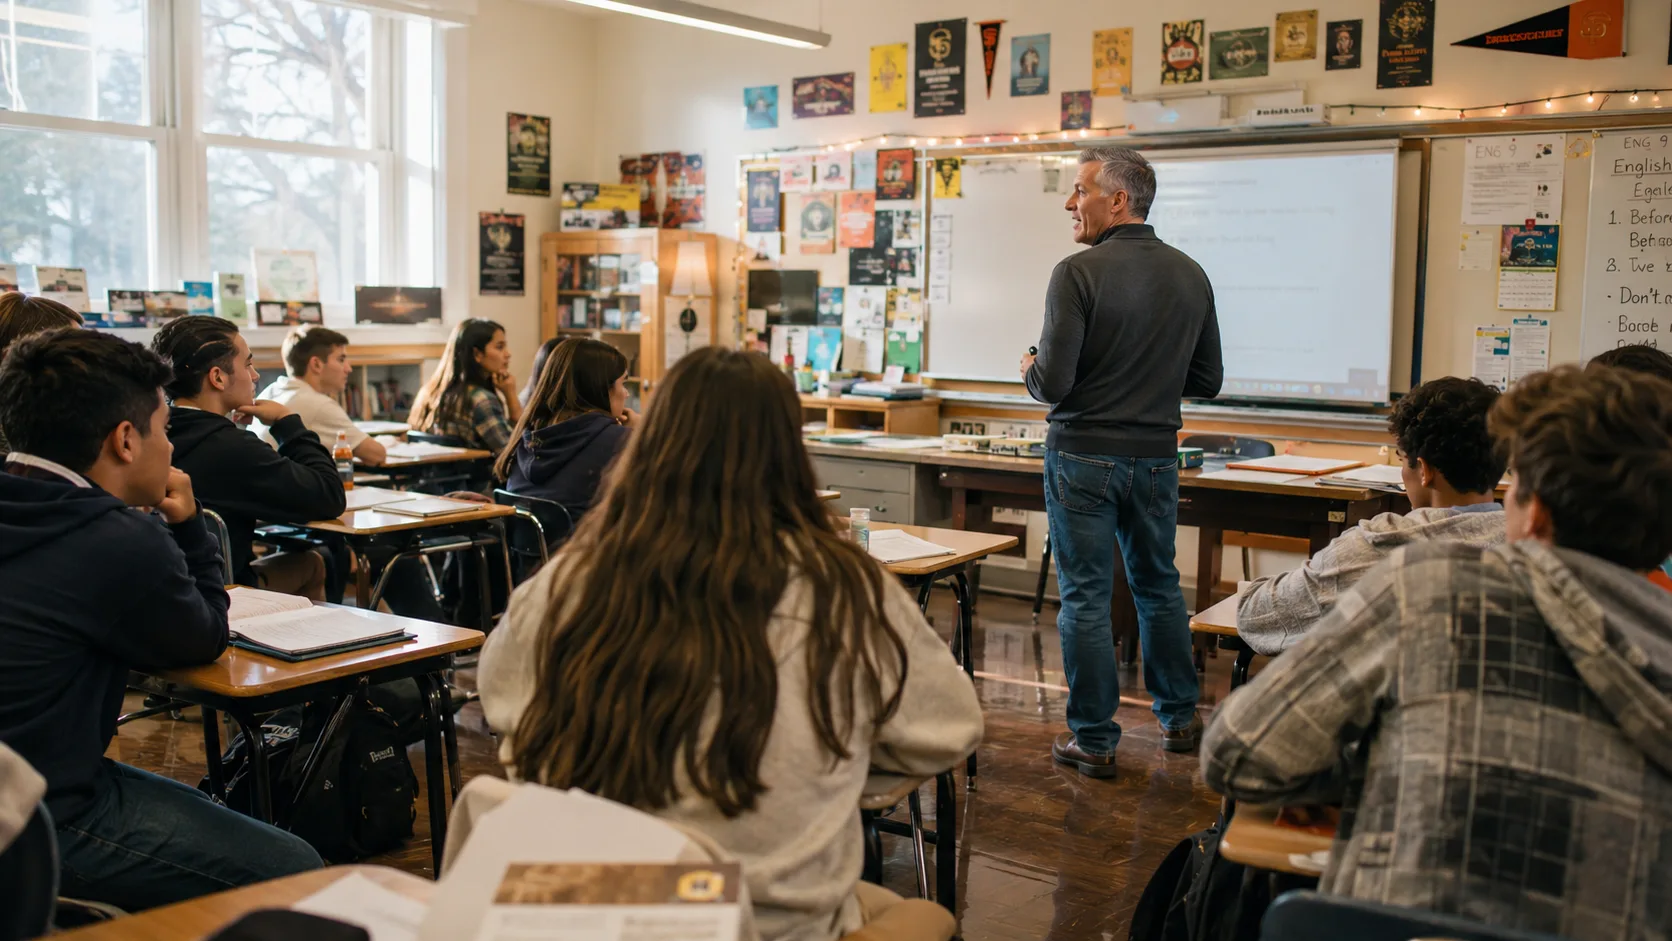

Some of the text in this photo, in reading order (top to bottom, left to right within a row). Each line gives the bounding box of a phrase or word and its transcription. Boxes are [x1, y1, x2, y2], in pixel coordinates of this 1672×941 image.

[1624, 134, 1668, 149] ENG 9
[1508, 144, 1517, 158] 9
[1613, 157, 1672, 179] English
[1608, 210, 1621, 225] 1.
